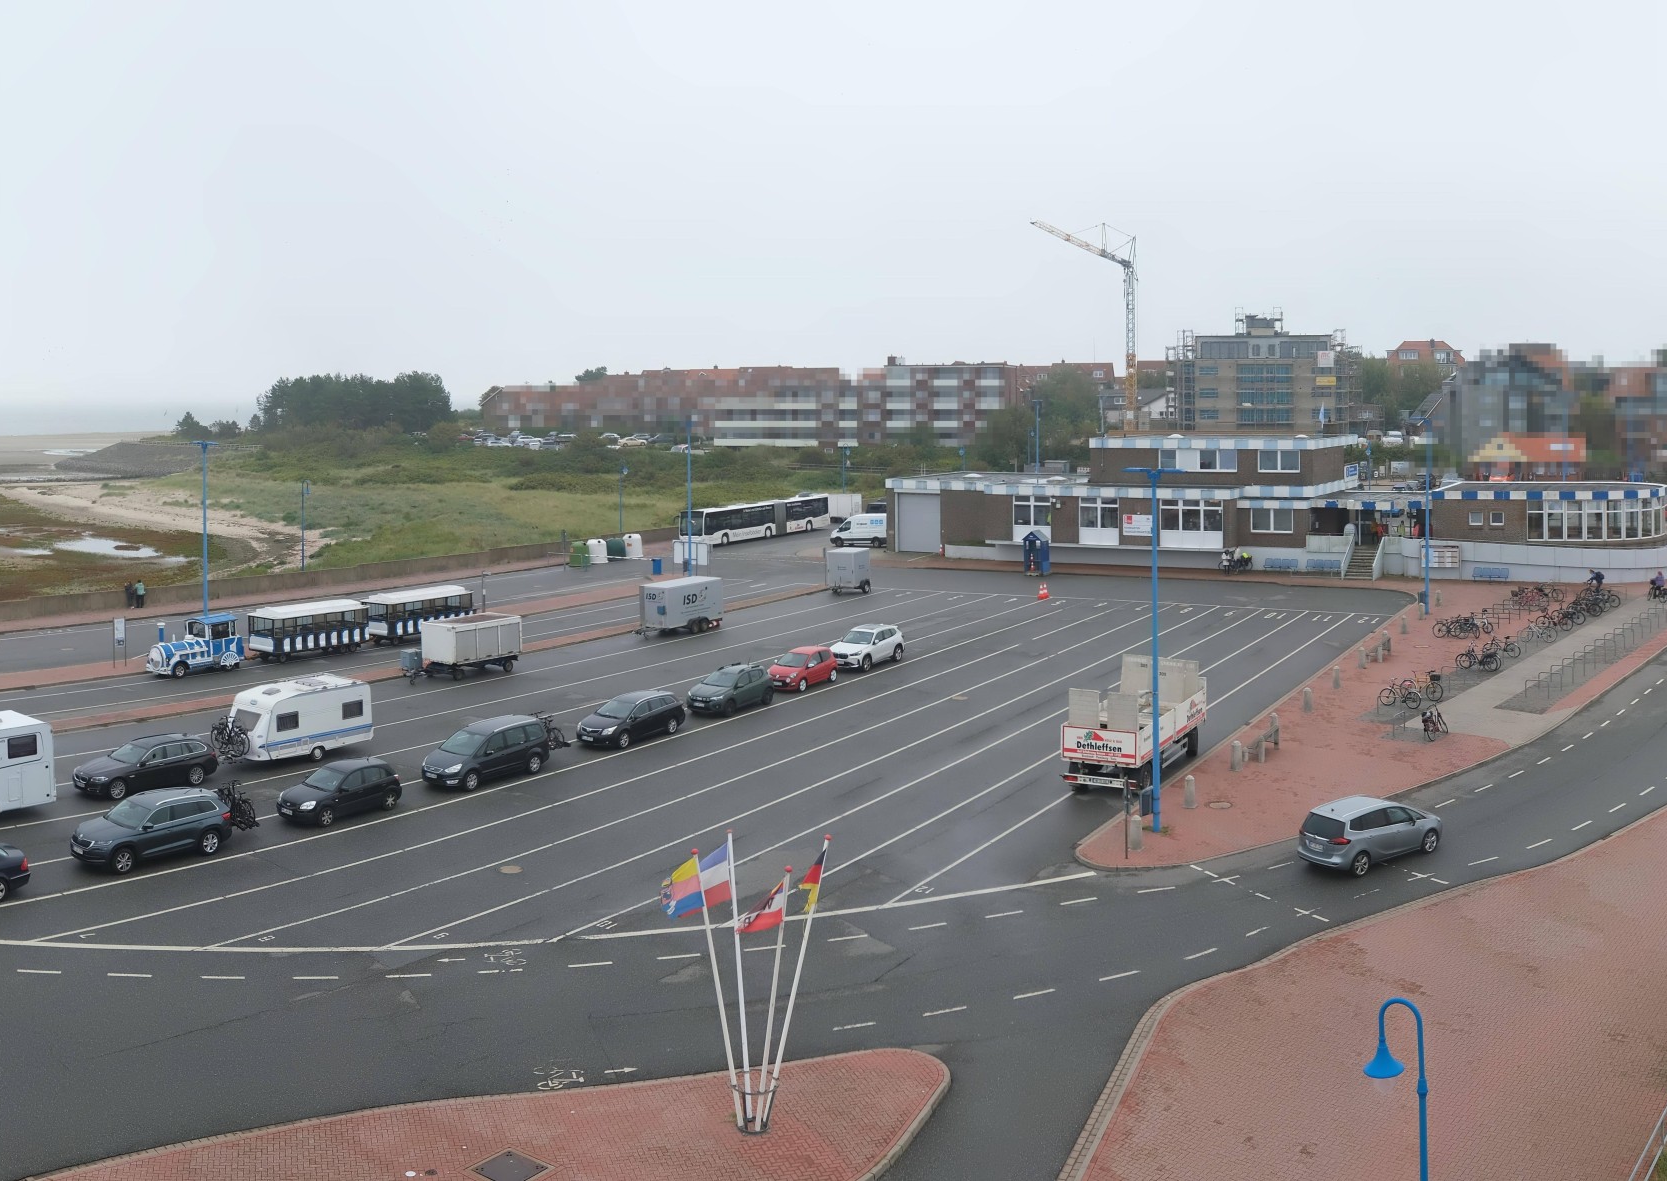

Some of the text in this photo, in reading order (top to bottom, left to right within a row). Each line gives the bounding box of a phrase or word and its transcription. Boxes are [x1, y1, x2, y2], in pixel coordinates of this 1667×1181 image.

[645, 592, 657, 600] ISD
[683, 593, 698, 606] ISD
[1076, 741, 1122, 752] Dethleffsen
